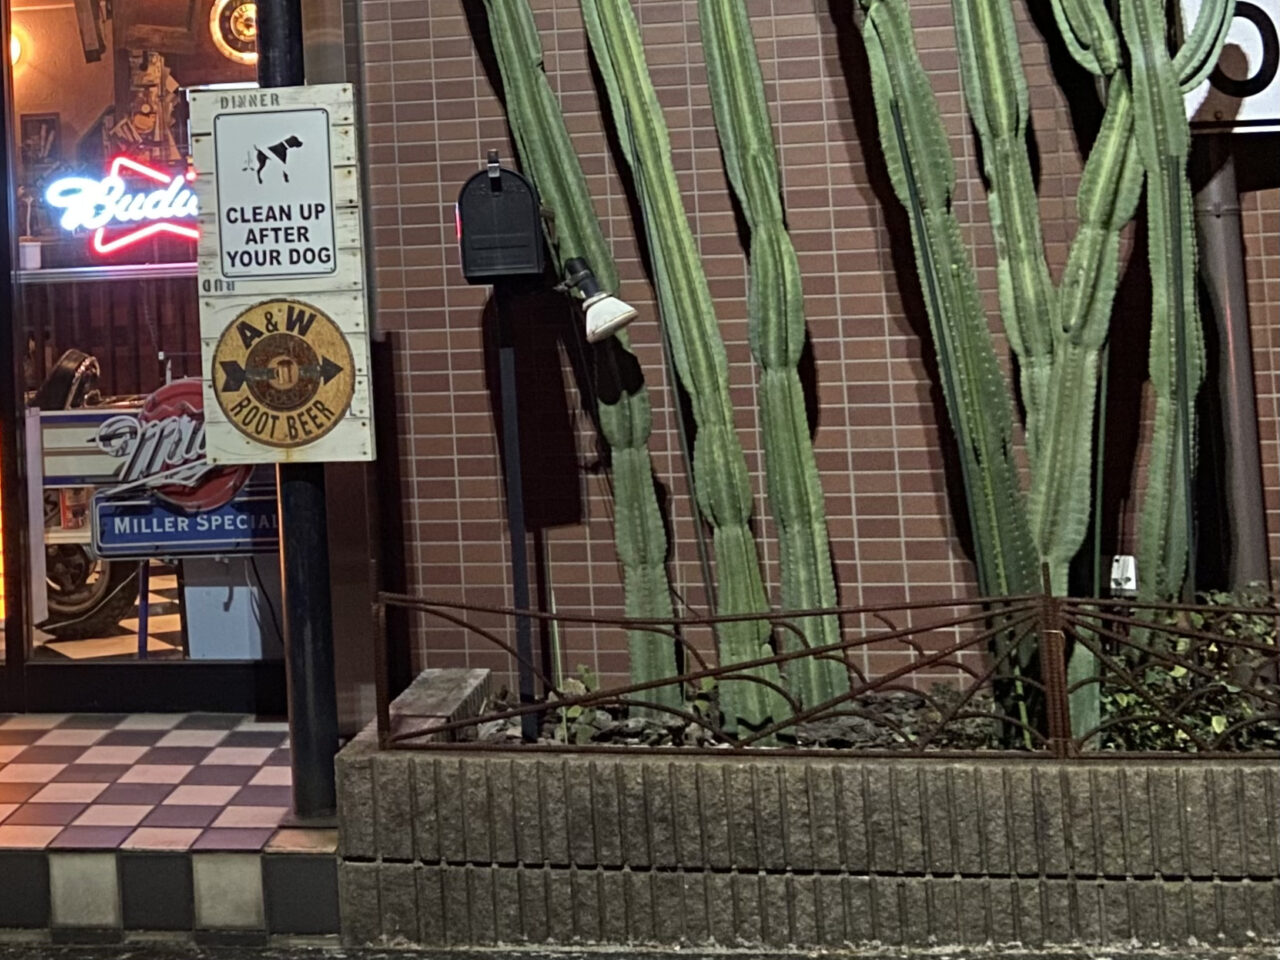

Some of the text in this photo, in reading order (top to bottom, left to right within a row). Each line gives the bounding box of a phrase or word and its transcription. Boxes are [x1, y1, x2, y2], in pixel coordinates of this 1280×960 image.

[220, 93, 280, 109] DINNER
[226, 203, 326, 224] CLEAN UP
[245, 226, 310, 245] AFTER
[226, 246, 332, 268] YOUR DOG
[230, 396, 335, 440] ROOT BEER
[114, 516, 189, 534] MILLER
